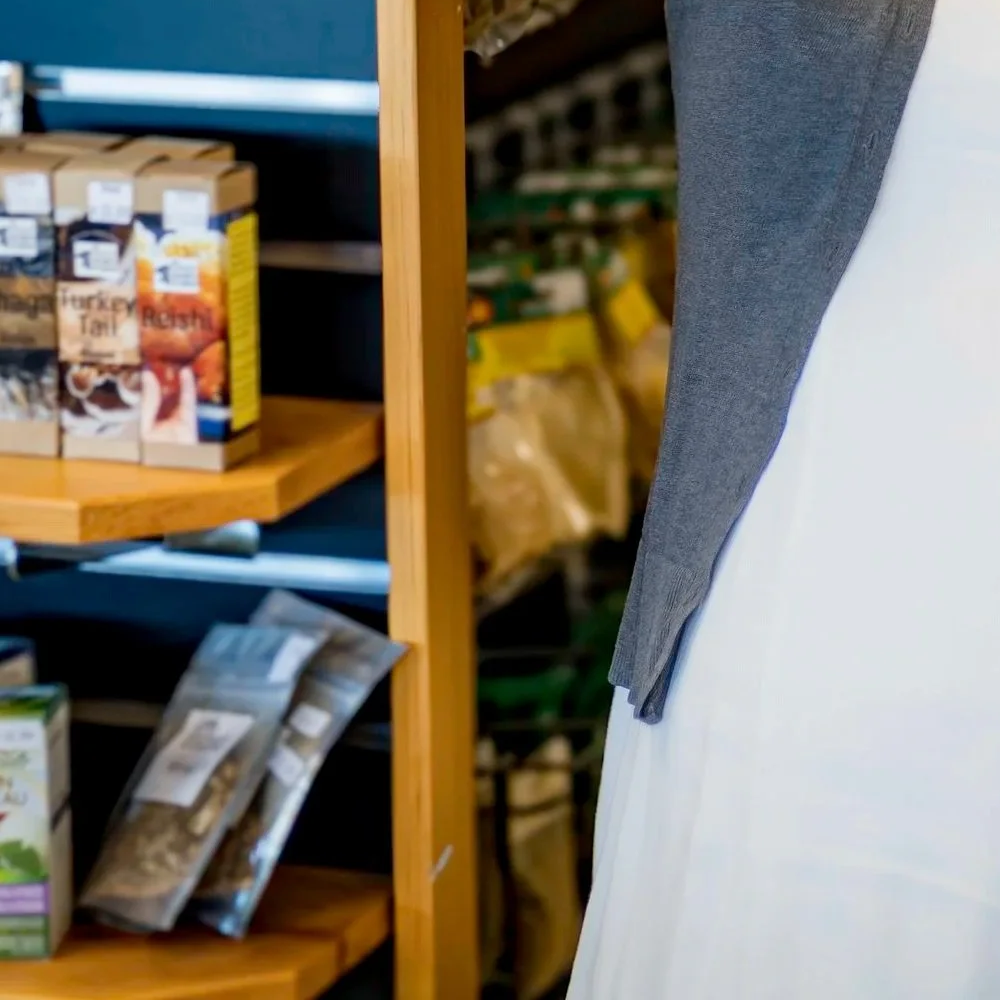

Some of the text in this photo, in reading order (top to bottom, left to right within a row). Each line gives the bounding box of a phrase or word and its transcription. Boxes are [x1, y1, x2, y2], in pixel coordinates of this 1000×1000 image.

[61, 287, 137, 316] Turkey
[79, 314, 118, 338] Tail
[142, 305, 214, 332] Reishi
